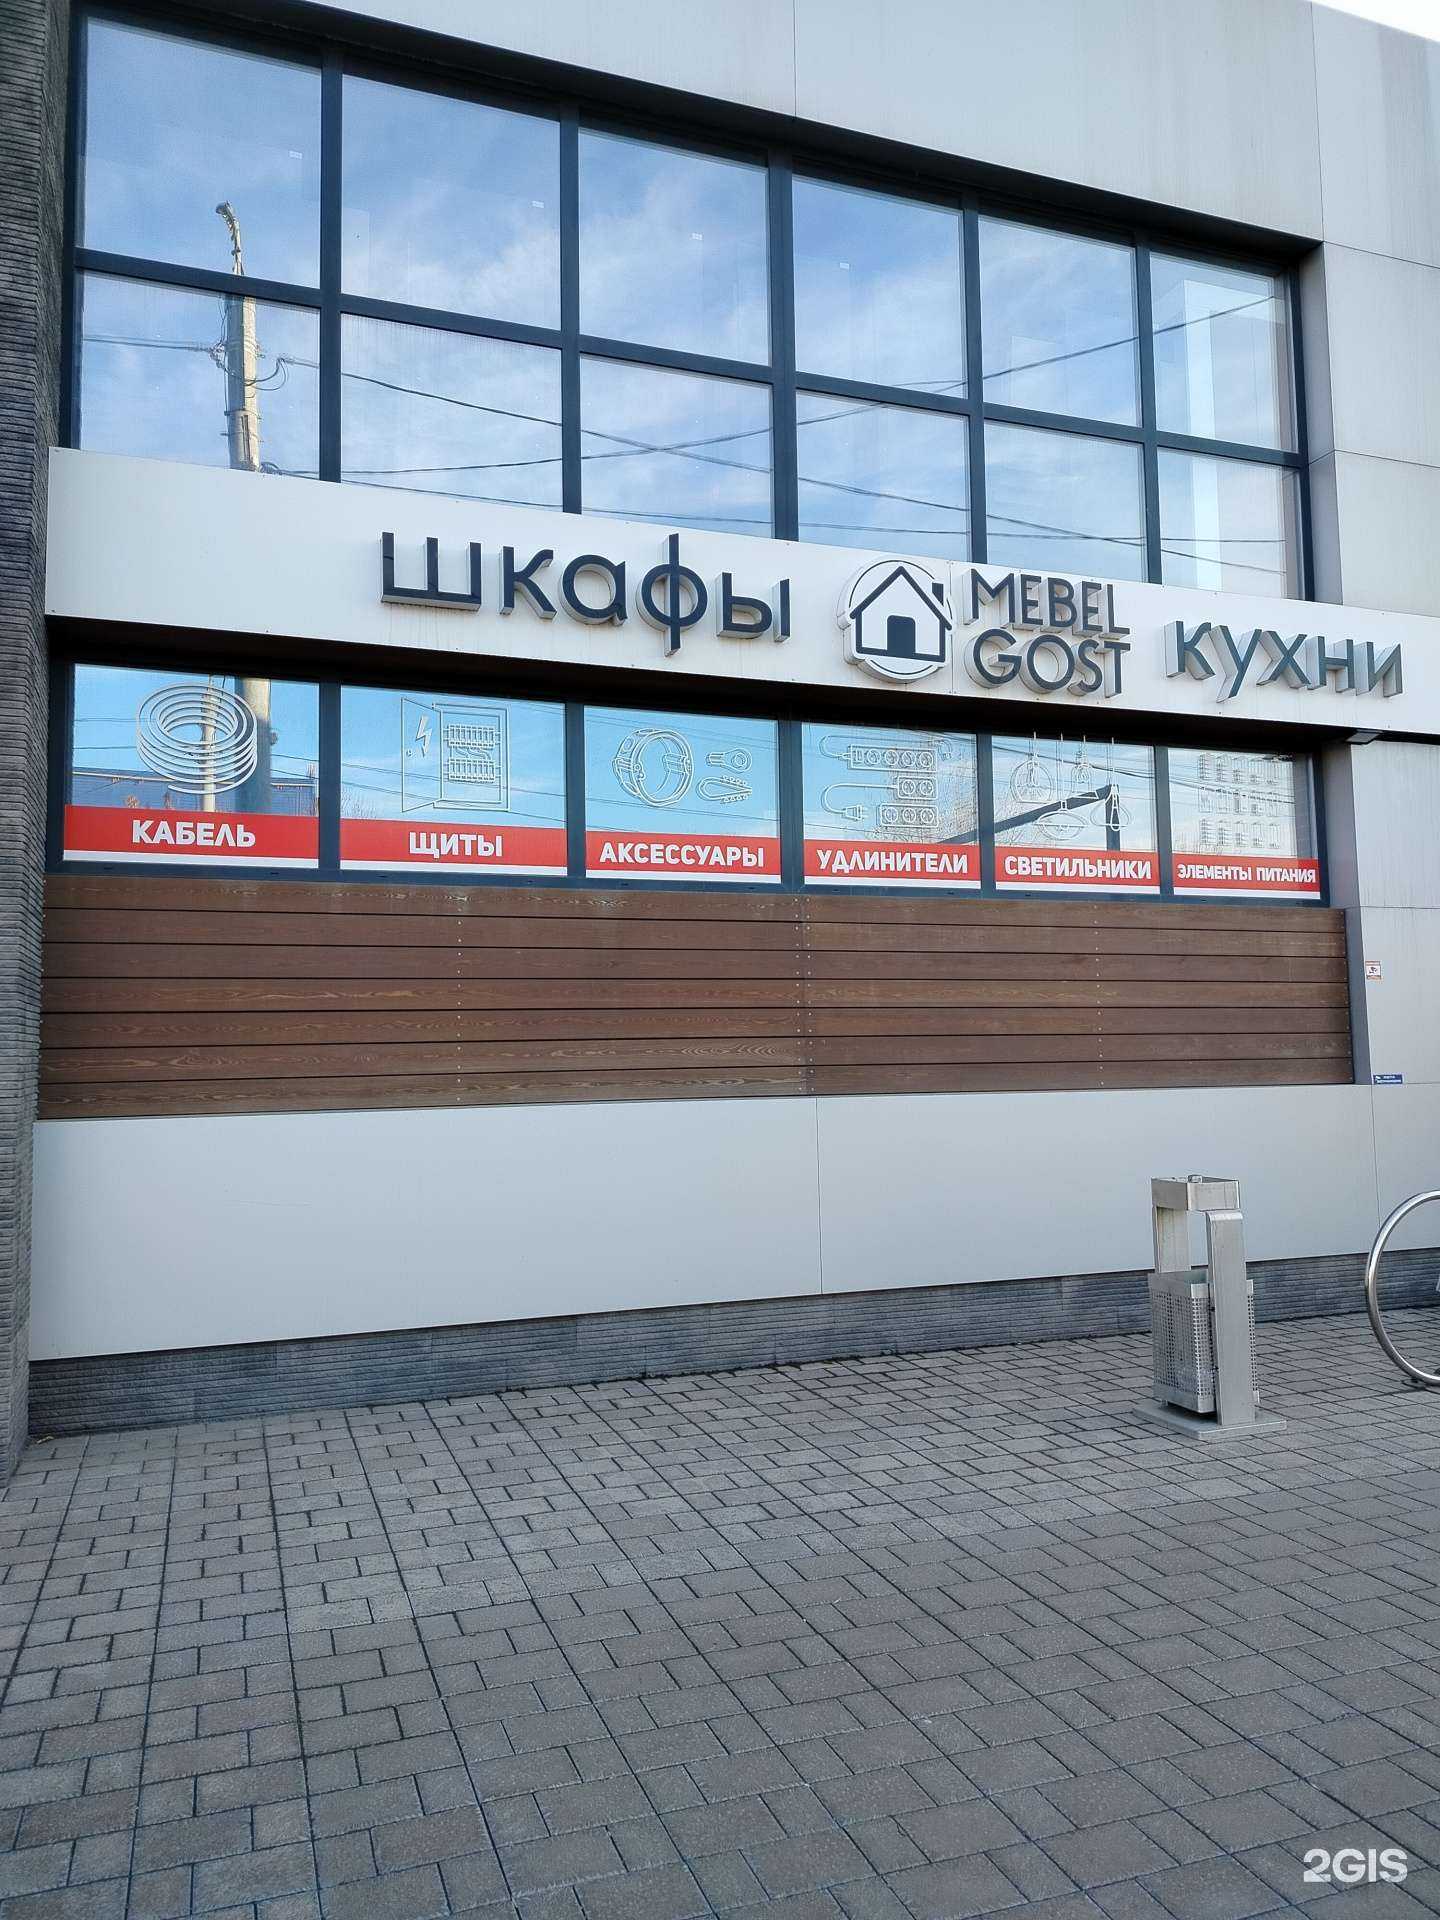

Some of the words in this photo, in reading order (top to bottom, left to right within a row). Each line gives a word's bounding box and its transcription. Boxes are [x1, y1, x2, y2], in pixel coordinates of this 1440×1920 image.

[968, 569, 1130, 634] MEBEL
[968, 628, 1131, 696] GOST
[131, 819, 257, 848] КАБЕЛЬ
[408, 832, 503, 859] ЩИТЫ
[600, 842, 764, 867] АКСЕССУАРЫ
[817, 849, 968, 875] УДЛИНИТЕЛИ
[1004, 856, 1152, 880] СВЕТИЛЬНИКИ
[1177, 864, 1252, 881] ЭЛЕМЕНТЫ
[1256, 866, 1316, 883] ПИТАНИЯ
